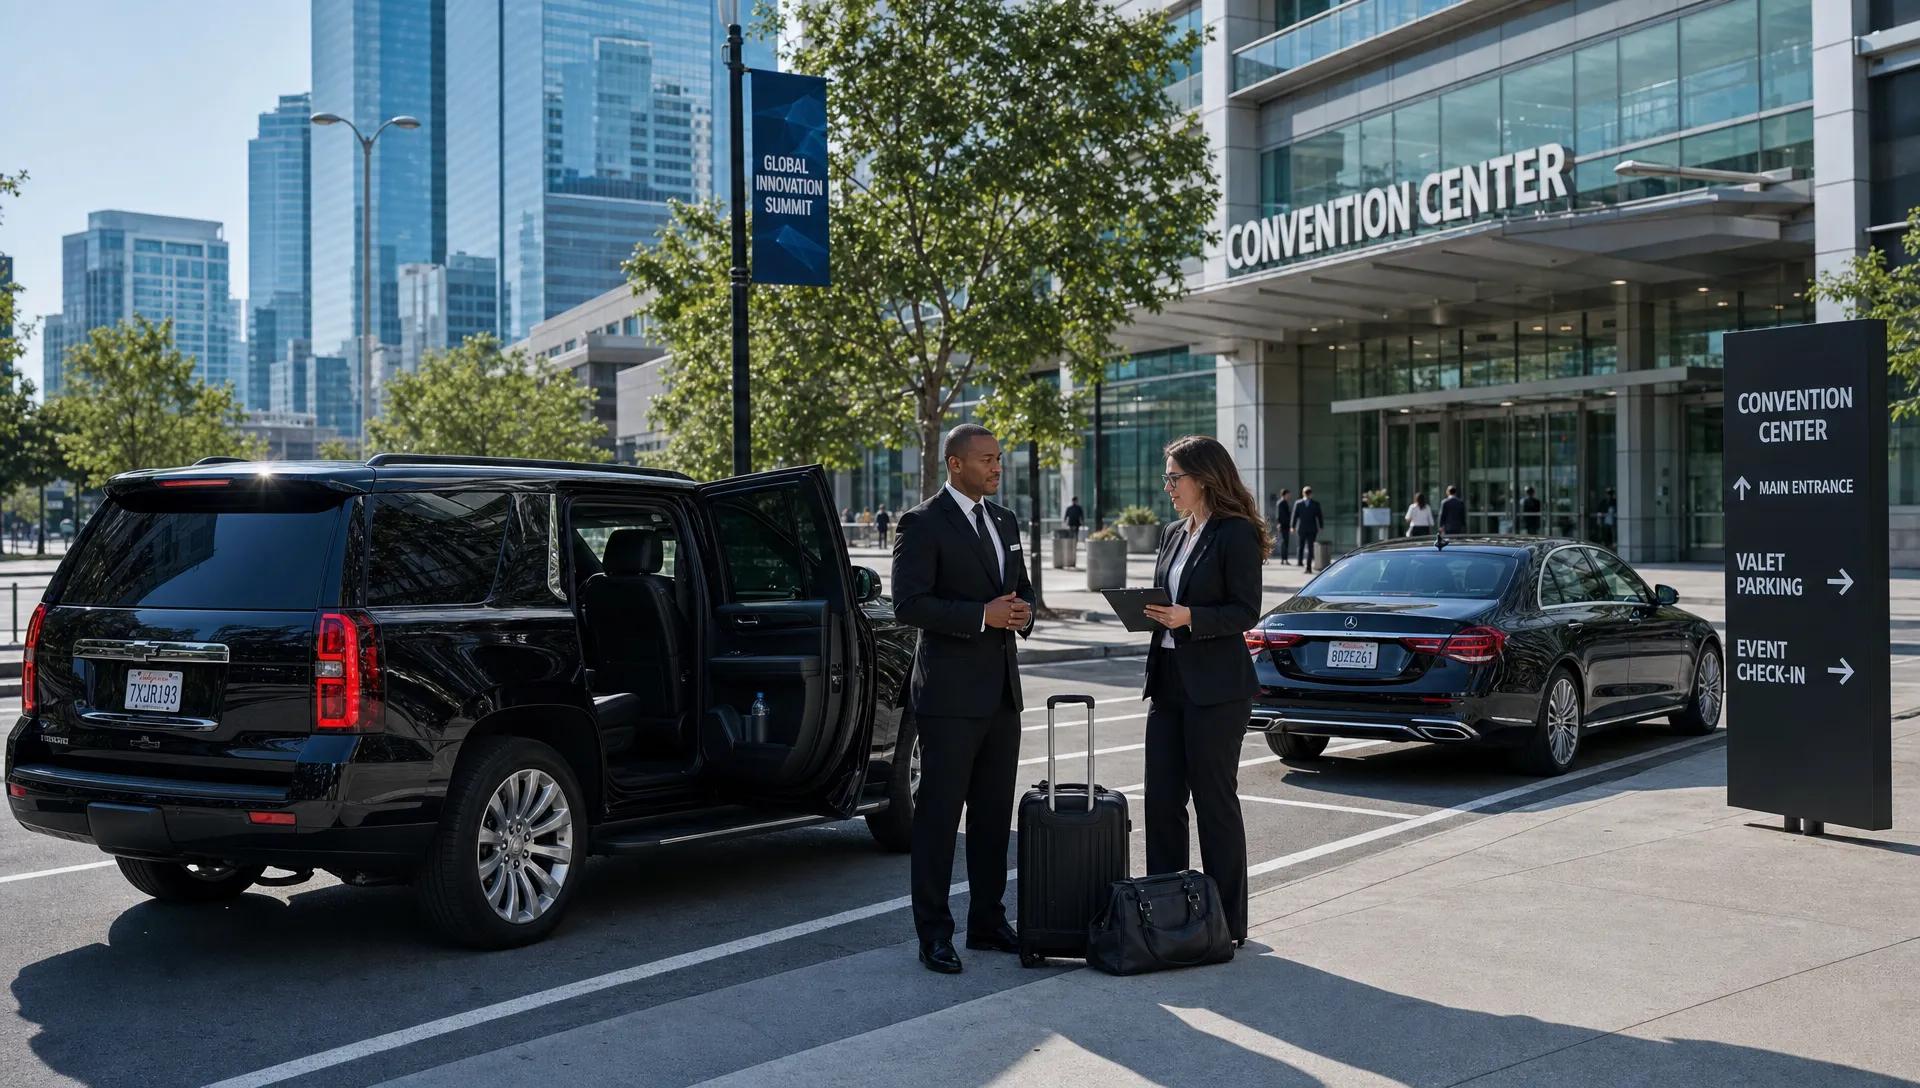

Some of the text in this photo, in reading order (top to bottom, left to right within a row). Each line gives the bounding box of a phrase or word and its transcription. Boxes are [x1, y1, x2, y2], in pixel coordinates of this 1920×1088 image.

[764, 154, 809, 174] GLOBAL
[756, 174, 823, 196] INNOVATION
[765, 196, 813, 216] SUMMIT
[1226, 143, 1568, 270] CONVENTION CENTER
[1737, 386, 1853, 414] CONVENTION
[1758, 419, 1828, 443] CENTER
[1759, 478, 1854, 495] MAIN ENTRANCE
[1736, 552, 1785, 572] VALET
[1736, 576, 1803, 596] PARKING
[1737, 639, 1788, 659] EVENT
[1736, 663, 1806, 685] CHECK-IN
[130, 683, 178, 705] 7XJR193
